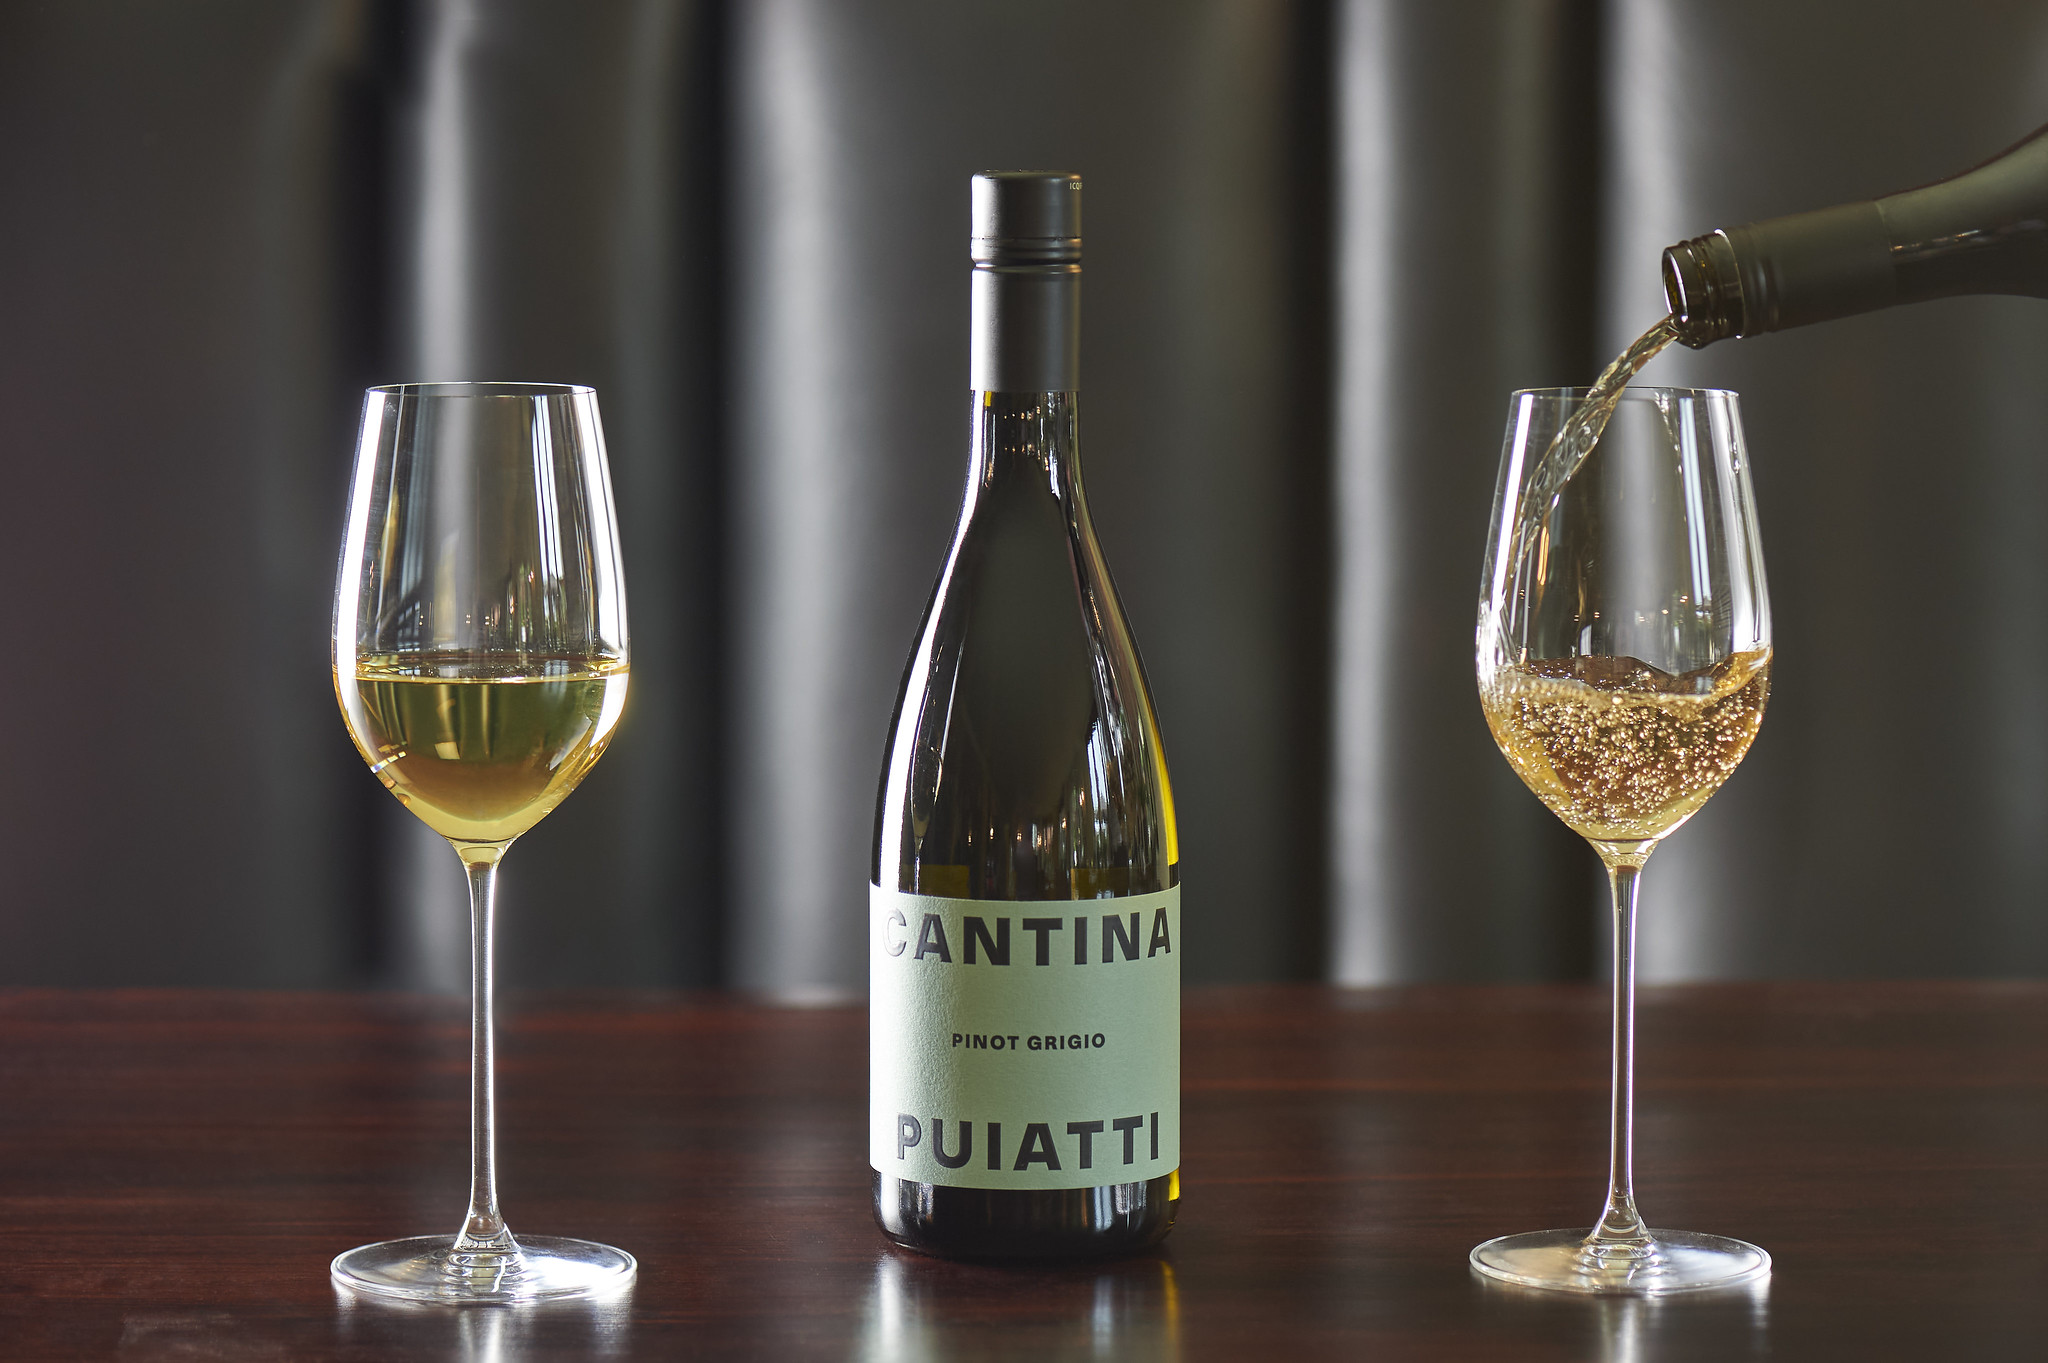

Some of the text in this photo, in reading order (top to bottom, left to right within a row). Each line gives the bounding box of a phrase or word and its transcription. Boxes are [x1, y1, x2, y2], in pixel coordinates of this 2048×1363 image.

[882, 907, 1171, 966] CANTINA
[952, 1033, 1106, 1050] PINOT GRIGIO
[897, 1112, 1159, 1171] PUIATTI
